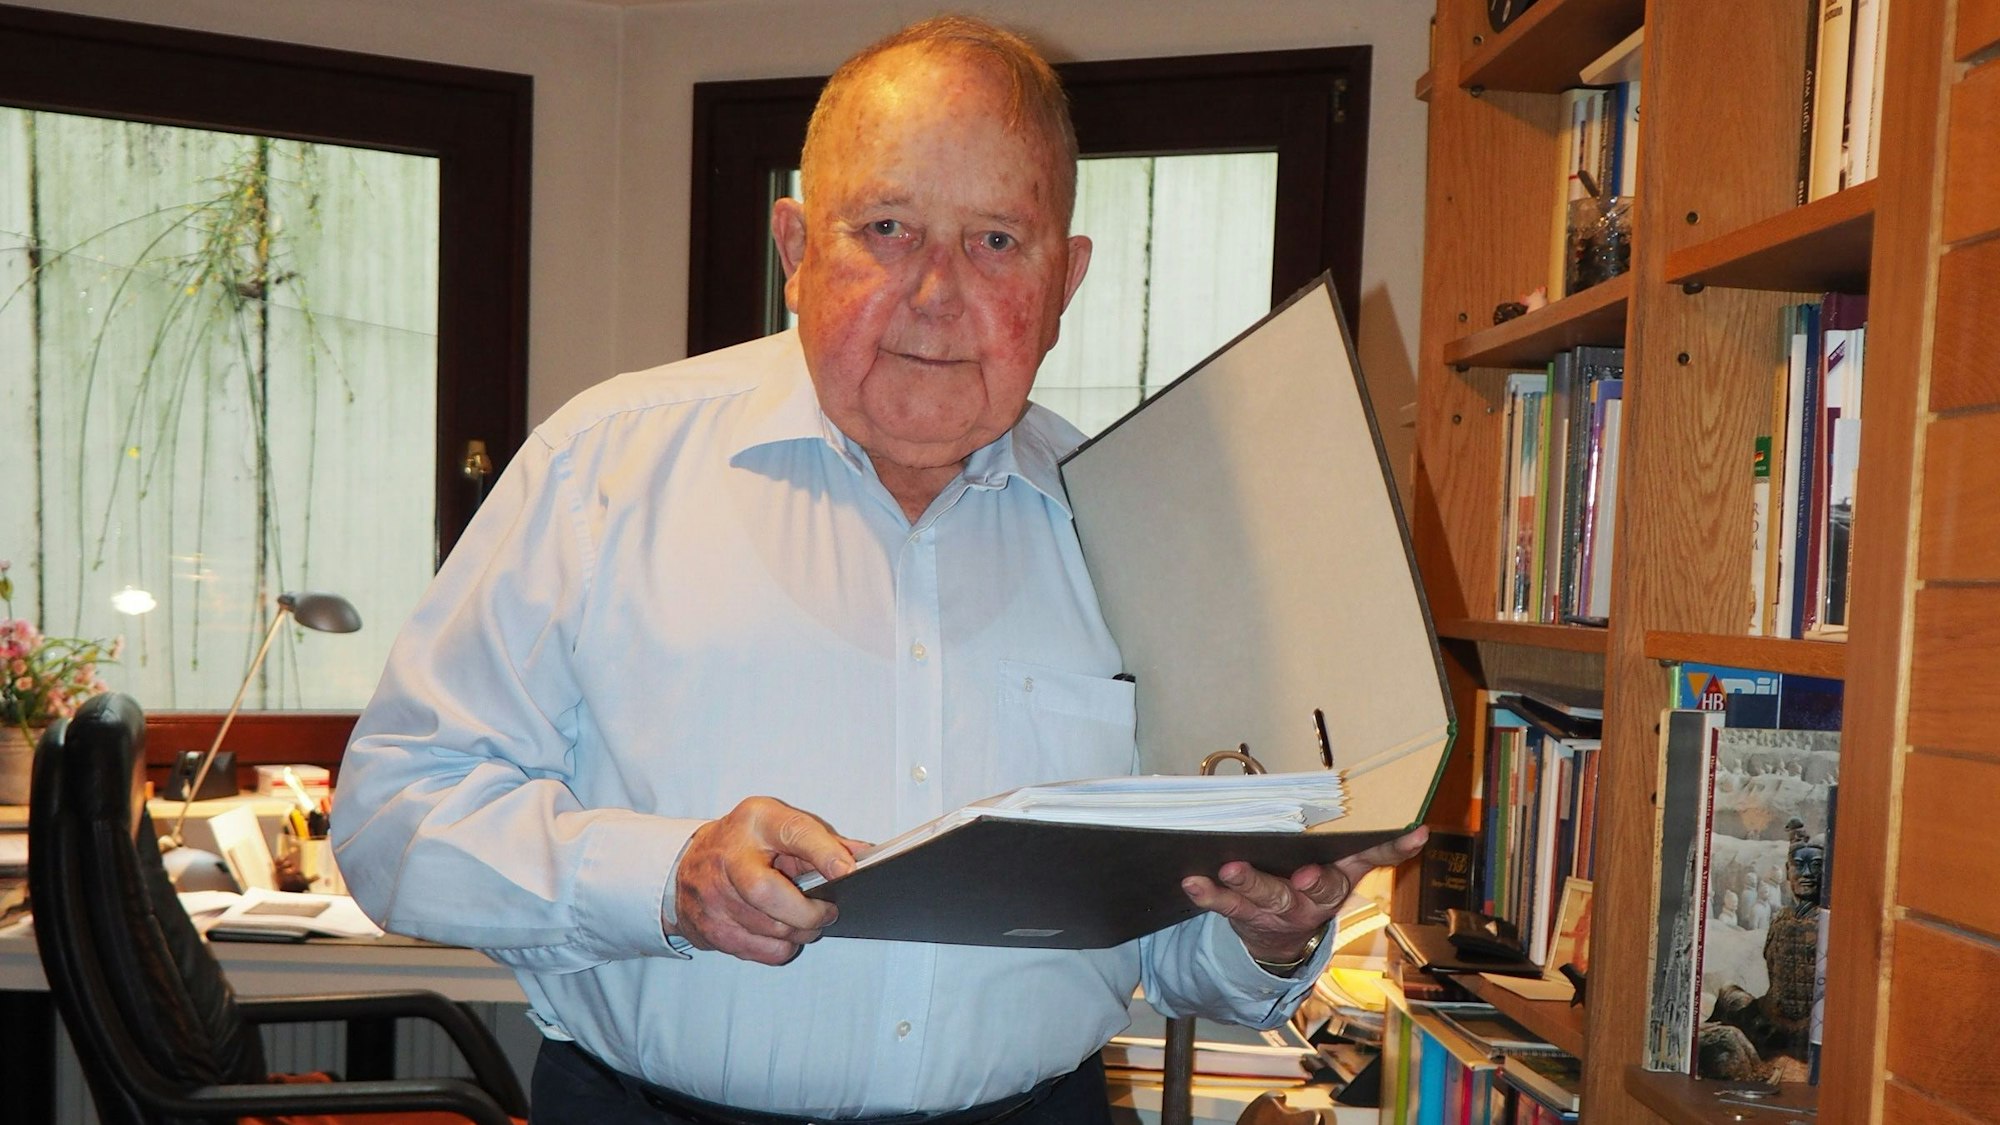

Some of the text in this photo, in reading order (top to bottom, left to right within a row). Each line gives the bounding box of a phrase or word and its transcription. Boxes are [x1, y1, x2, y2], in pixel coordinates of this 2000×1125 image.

[1804, 69, 1813, 98] way
[1802, 101, 1810, 133] right
[1799, 460, 1807, 501] Brummen
[1702, 692, 1724, 711] HB
